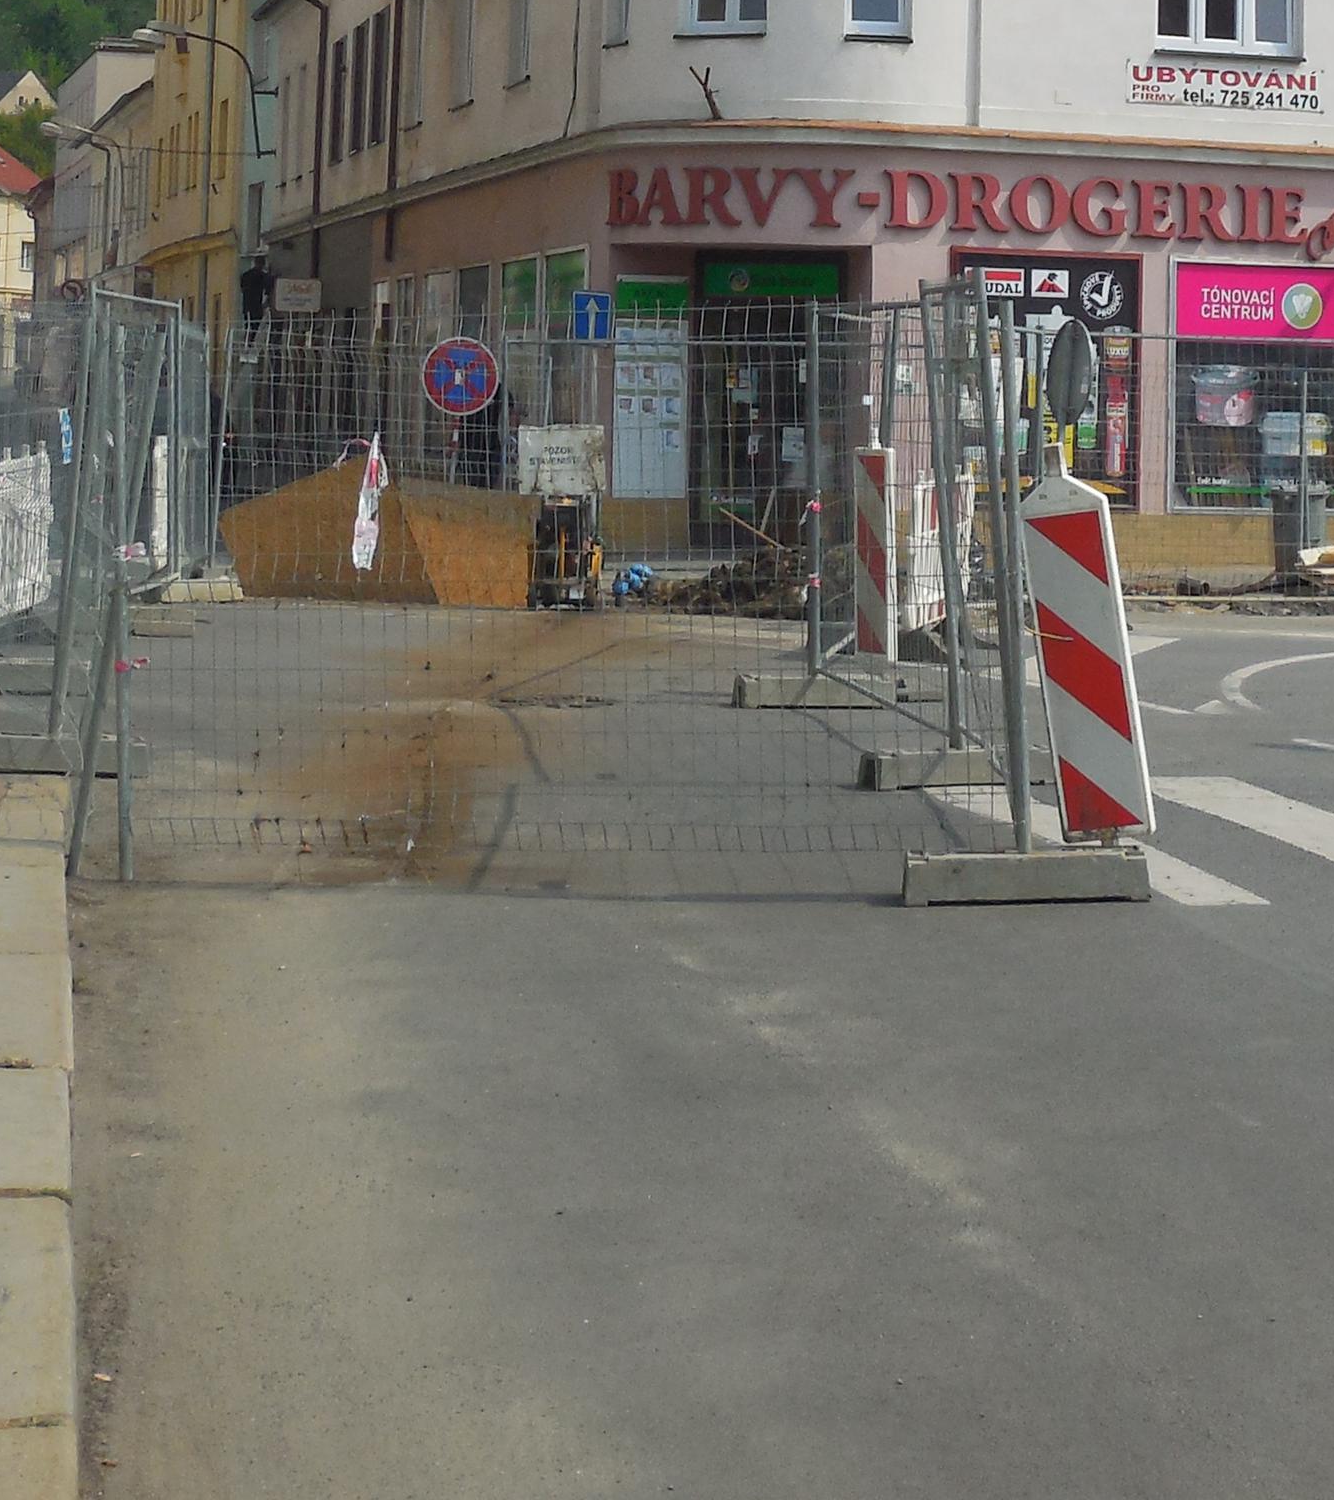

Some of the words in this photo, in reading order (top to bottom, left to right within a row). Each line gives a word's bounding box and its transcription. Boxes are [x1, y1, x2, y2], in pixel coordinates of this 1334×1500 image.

[1132, 65, 1317, 91] UBYTOVÁNÍ
[1132, 84, 1160, 93] PRO
[1132, 92, 1175, 102] FIRMY
[1183, 89, 1215, 104] tel.:
[1220, 90, 1250, 105] 725
[1255, 92, 1283, 107] 241
[1290, 94, 1319, 109] 470
[1201, 285, 1275, 304] TÓNOVACÍ
[1201, 304, 1274, 321] CENTRUM
